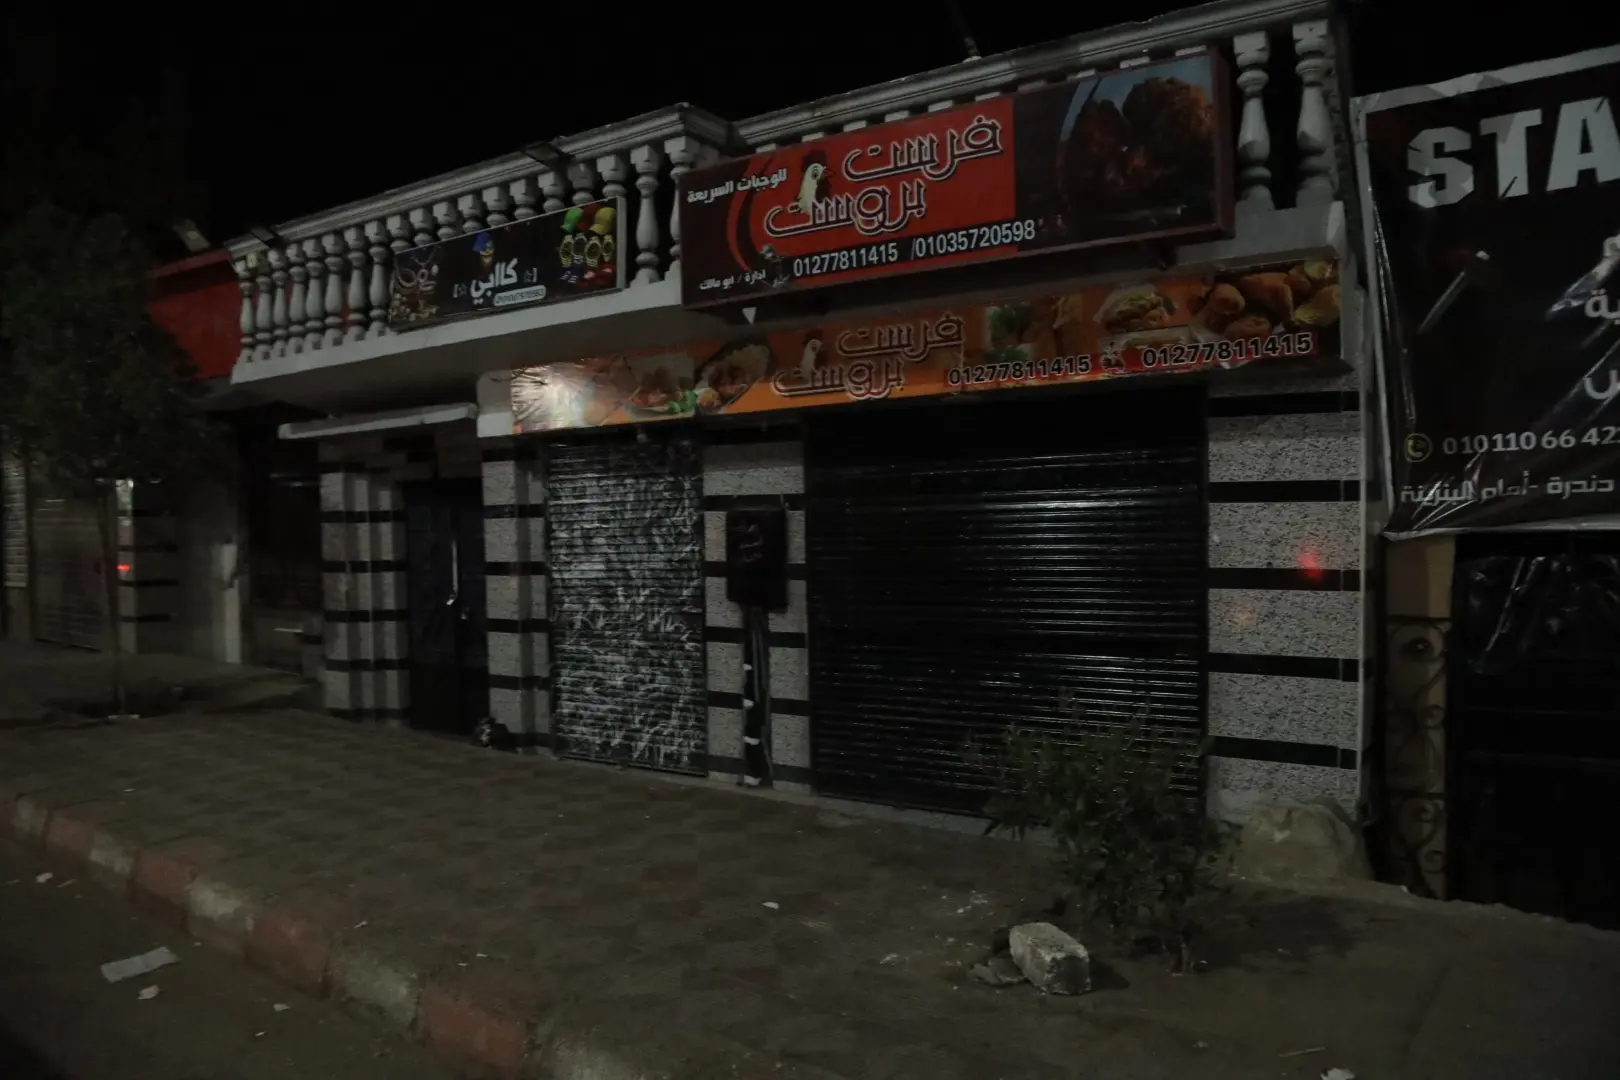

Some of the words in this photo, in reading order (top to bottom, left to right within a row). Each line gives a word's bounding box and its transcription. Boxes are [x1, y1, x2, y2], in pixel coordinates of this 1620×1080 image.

[842, 114, 1002, 182] فرست
[687, 180, 735, 204] السريعة
[764, 178, 928, 238] بروست
[793, 242, 899, 277] 01277811415
[836, 312, 965, 361] فرست
[947, 355, 1091, 386] 01277811415
[1142, 331, 1313, 368] 01277811415
[770, 356, 905, 399] بروست
